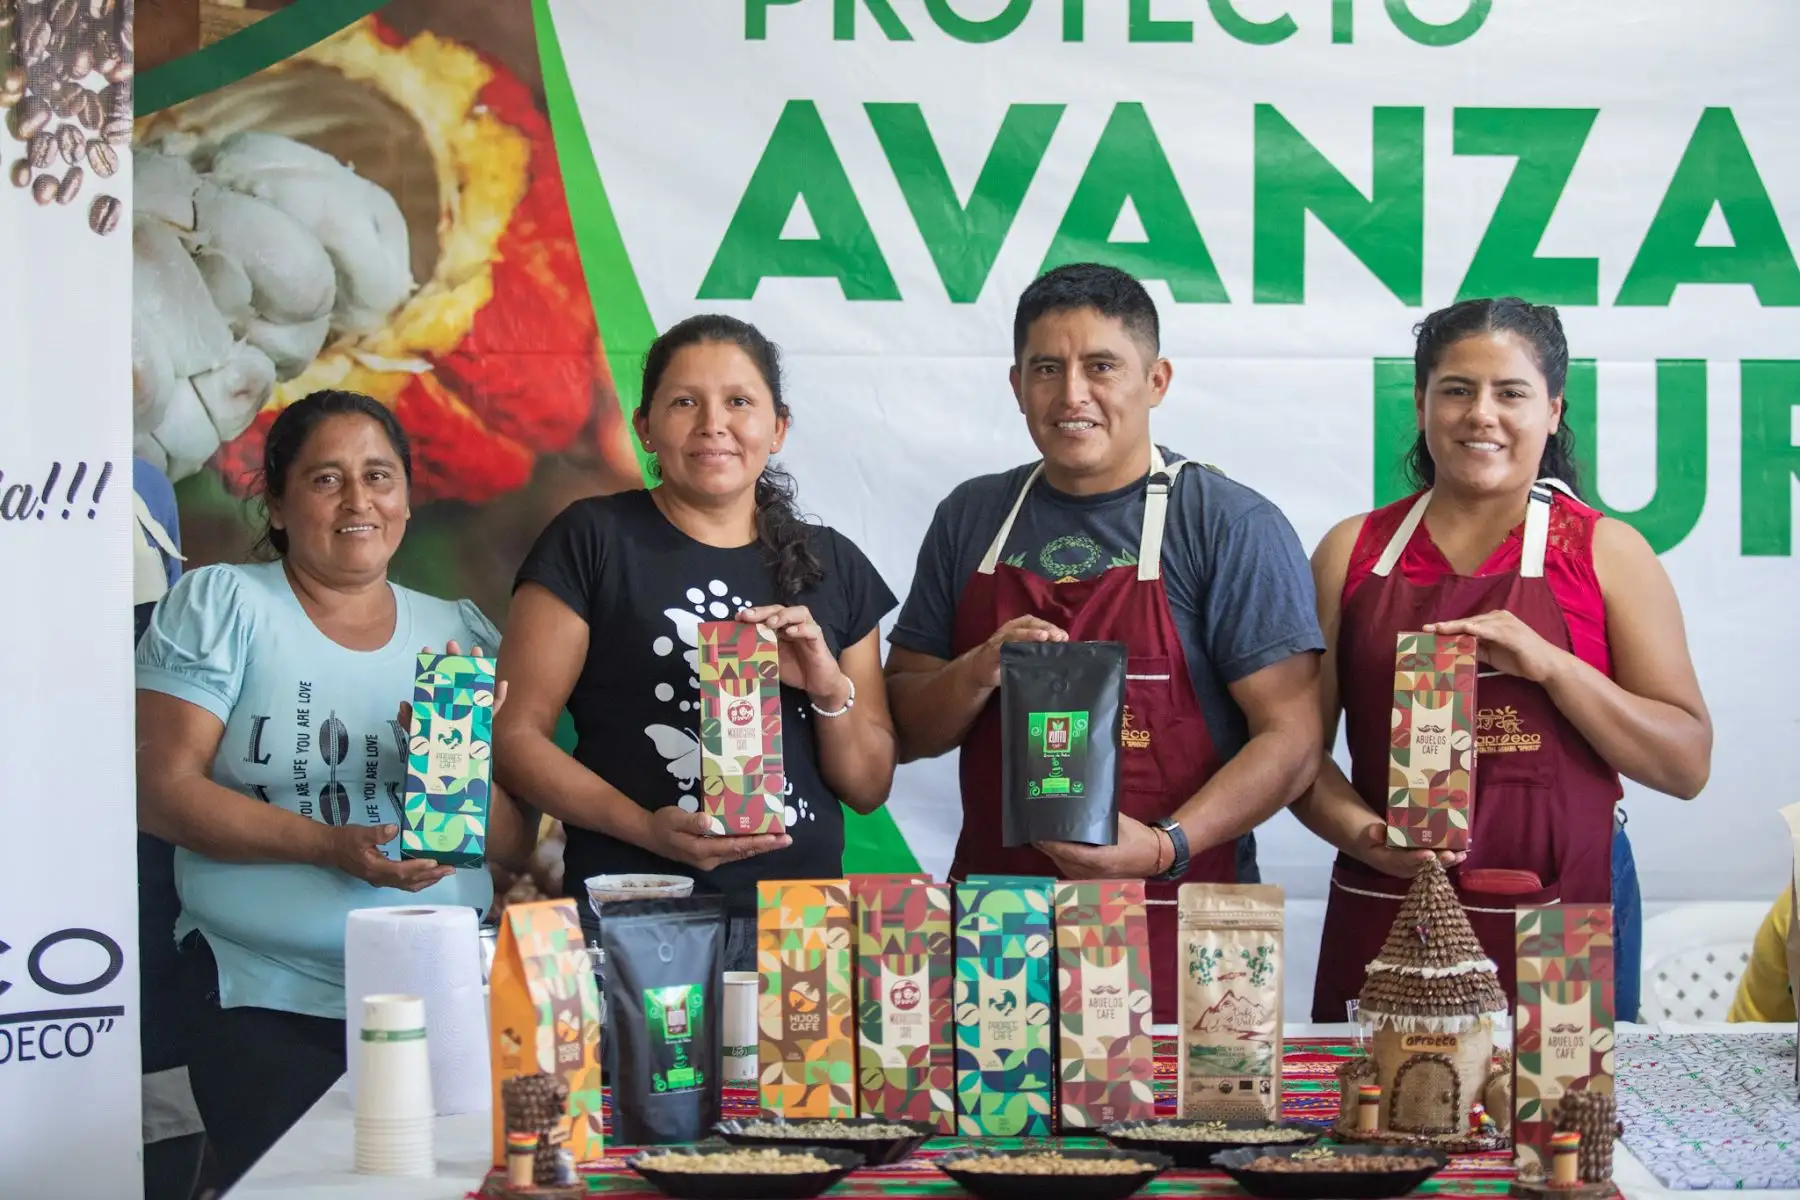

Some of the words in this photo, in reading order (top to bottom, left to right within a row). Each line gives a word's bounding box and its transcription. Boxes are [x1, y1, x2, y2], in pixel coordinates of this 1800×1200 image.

[696, 99, 1800, 306] AVANZA
[0, 461, 114, 521] a!!!
[299, 680, 312, 704] LOVE
[297, 709, 310, 728] ARE
[296, 733, 310, 755] YOU
[365, 734, 378, 758] LOVE
[1416, 735, 1447, 745] ABUELOS
[294, 758, 308, 781] LIFE
[365, 762, 379, 780] ARE
[364, 782, 376, 803] YOU
[300, 801, 313, 819] OU
[365, 804, 381, 824] LIFE
[0, 928, 124, 996] O
[1088, 997, 1124, 1008] ABUELOS
[789, 1013, 820, 1023] HIJOS
[790, 1022, 820, 1032] CAFE
[1547, 1035, 1585, 1047] ABUELOS
